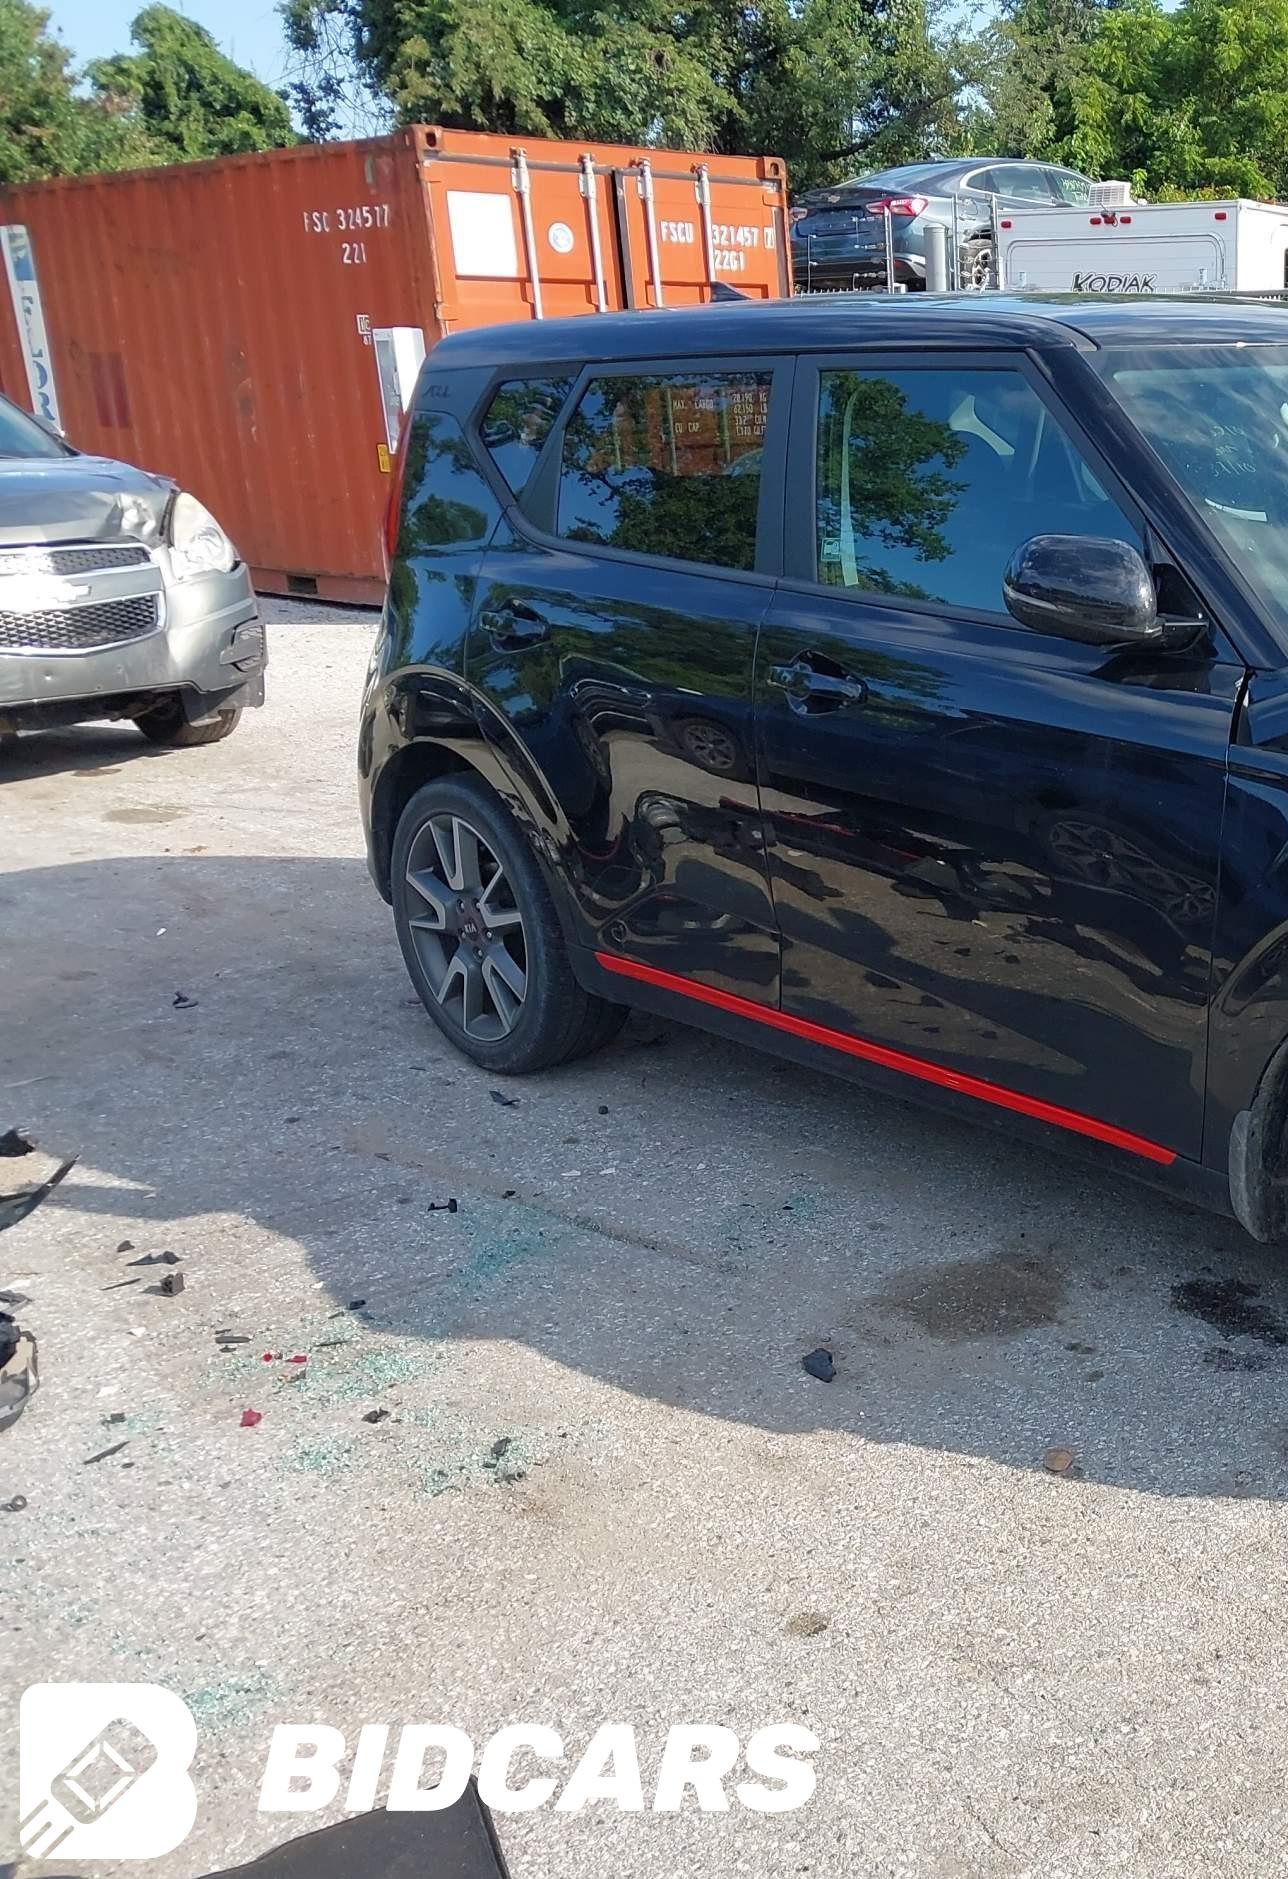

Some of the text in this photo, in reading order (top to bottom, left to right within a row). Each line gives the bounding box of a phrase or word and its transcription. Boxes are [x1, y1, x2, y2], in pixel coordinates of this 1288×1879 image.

[660, 220, 694, 244] FSCU
[711, 224, 759, 247] 321457
[714, 249, 745, 271] 22G1
[1072, 272, 1156, 293] KODIAK
[464, 922, 476, 933] KIA
